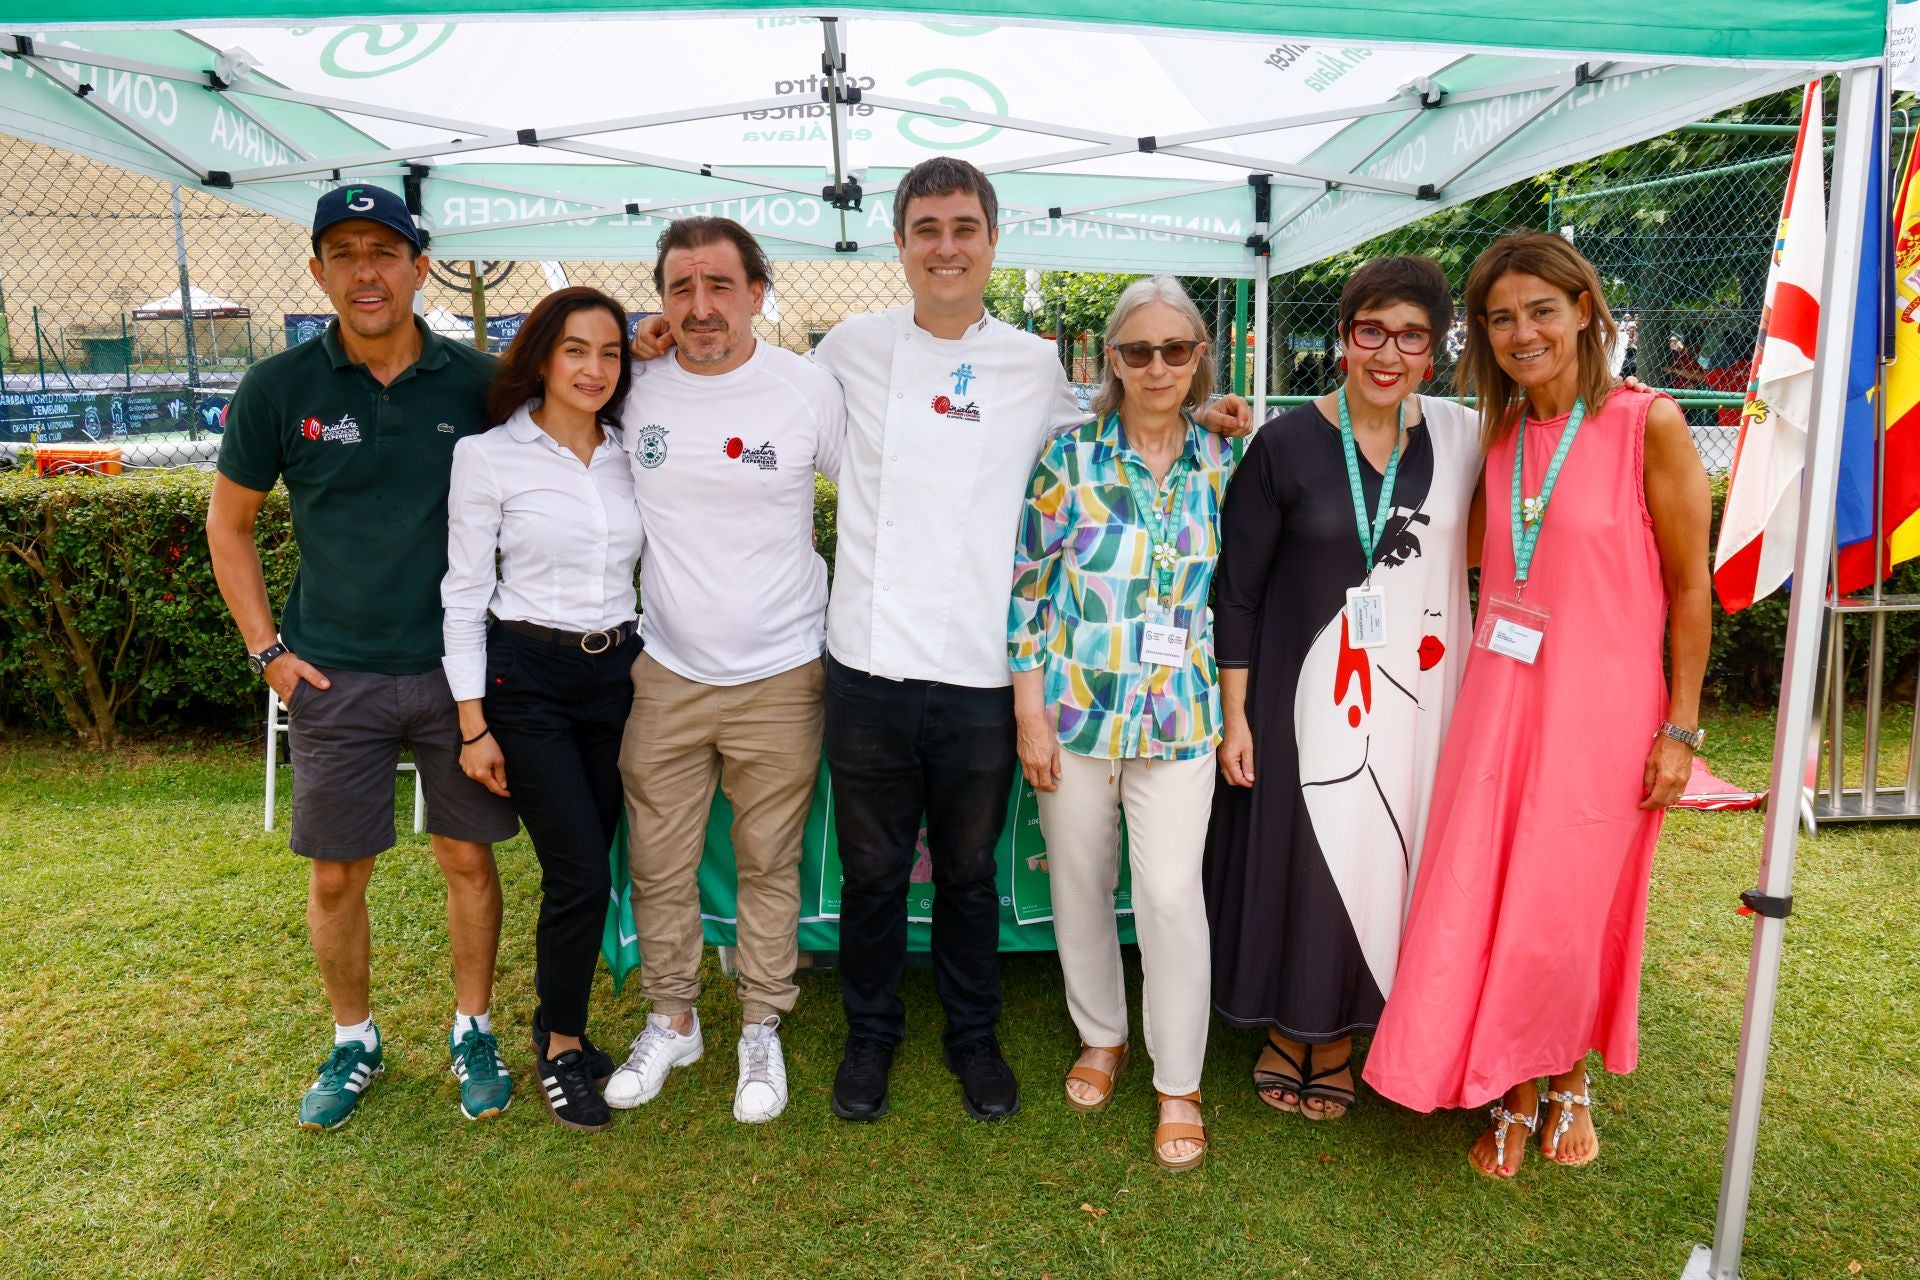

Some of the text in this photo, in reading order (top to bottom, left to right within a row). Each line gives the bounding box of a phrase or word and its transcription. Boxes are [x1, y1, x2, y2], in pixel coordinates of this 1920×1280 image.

[26, 393, 54, 405] WORLD
[33, 403, 69, 416] FEMENINO
[29, 422, 46, 432] PEA
